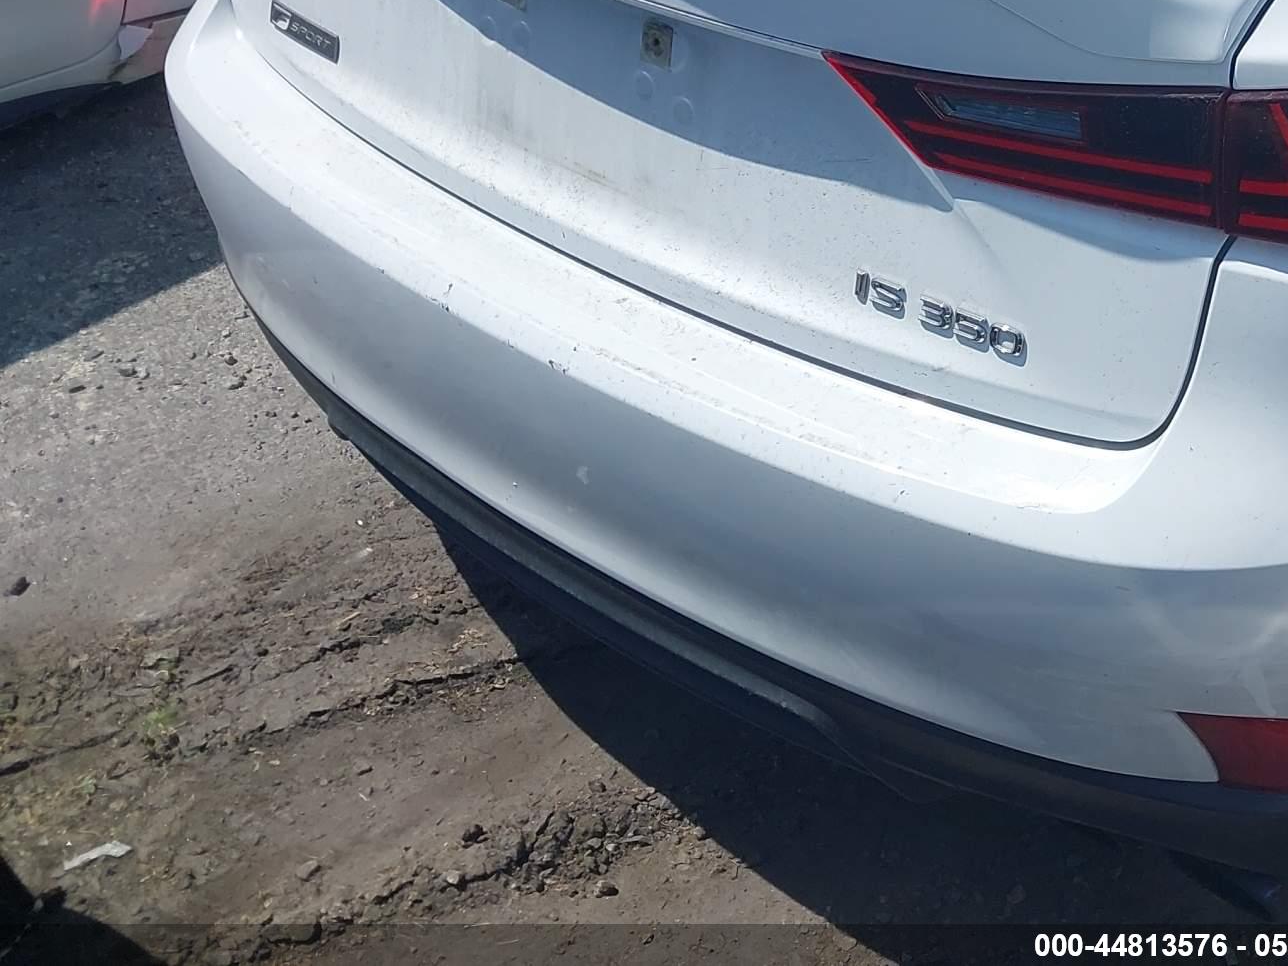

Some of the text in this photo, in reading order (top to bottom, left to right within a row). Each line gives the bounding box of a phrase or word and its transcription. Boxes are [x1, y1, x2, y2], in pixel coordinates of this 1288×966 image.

[290, 22, 331, 49] SPORT
[854, 268, 1026, 357] IS 350
